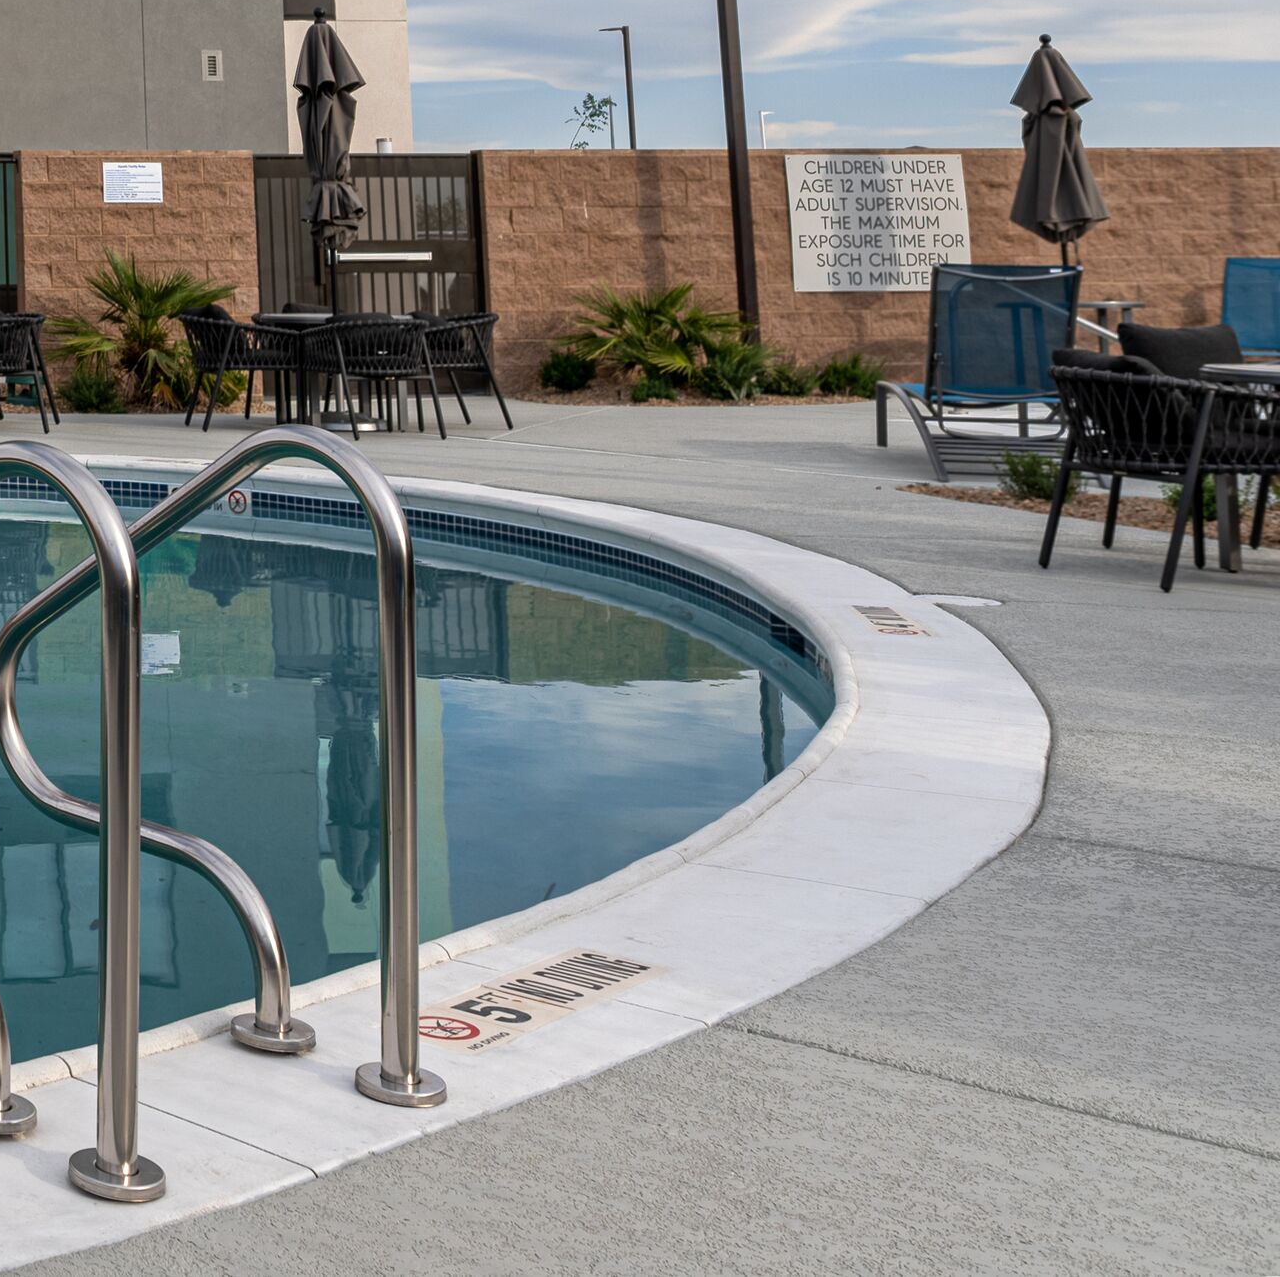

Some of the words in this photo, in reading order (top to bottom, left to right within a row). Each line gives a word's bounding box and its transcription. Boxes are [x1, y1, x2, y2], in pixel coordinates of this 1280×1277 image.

[805, 161, 884, 174] CHILDREN
[892, 161, 946, 174] UNDER
[800, 179, 833, 193] AGE
[840, 179, 854, 193] 12
[861, 179, 903, 193] MUST
[911, 179, 954, 192] HAVE
[795, 198, 848, 211] ADULT
[855, 197, 963, 211] SUPERVISION.
[821, 216, 851, 230] THE
[859, 216, 940, 230] MAXIMUM
[799, 234, 882, 248] EXPOSURE
[889, 234, 925, 248] TIME
[933, 234, 964, 247] FOR
[817, 253, 862, 267] SUCH
[869, 253, 949, 267] CHILDREN
[828, 272, 840, 286] IS
[849, 272, 862, 286] 10
[870, 271, 931, 286] MINUTE
[532, 953, 651, 990] DIVING
[476, 992, 510, 1004] FT
[500, 979, 584, 1004] NO
[451, 999, 532, 1023] 5
[467, 1042, 484, 1052] NO
[483, 1031, 510, 1046] DIVING
